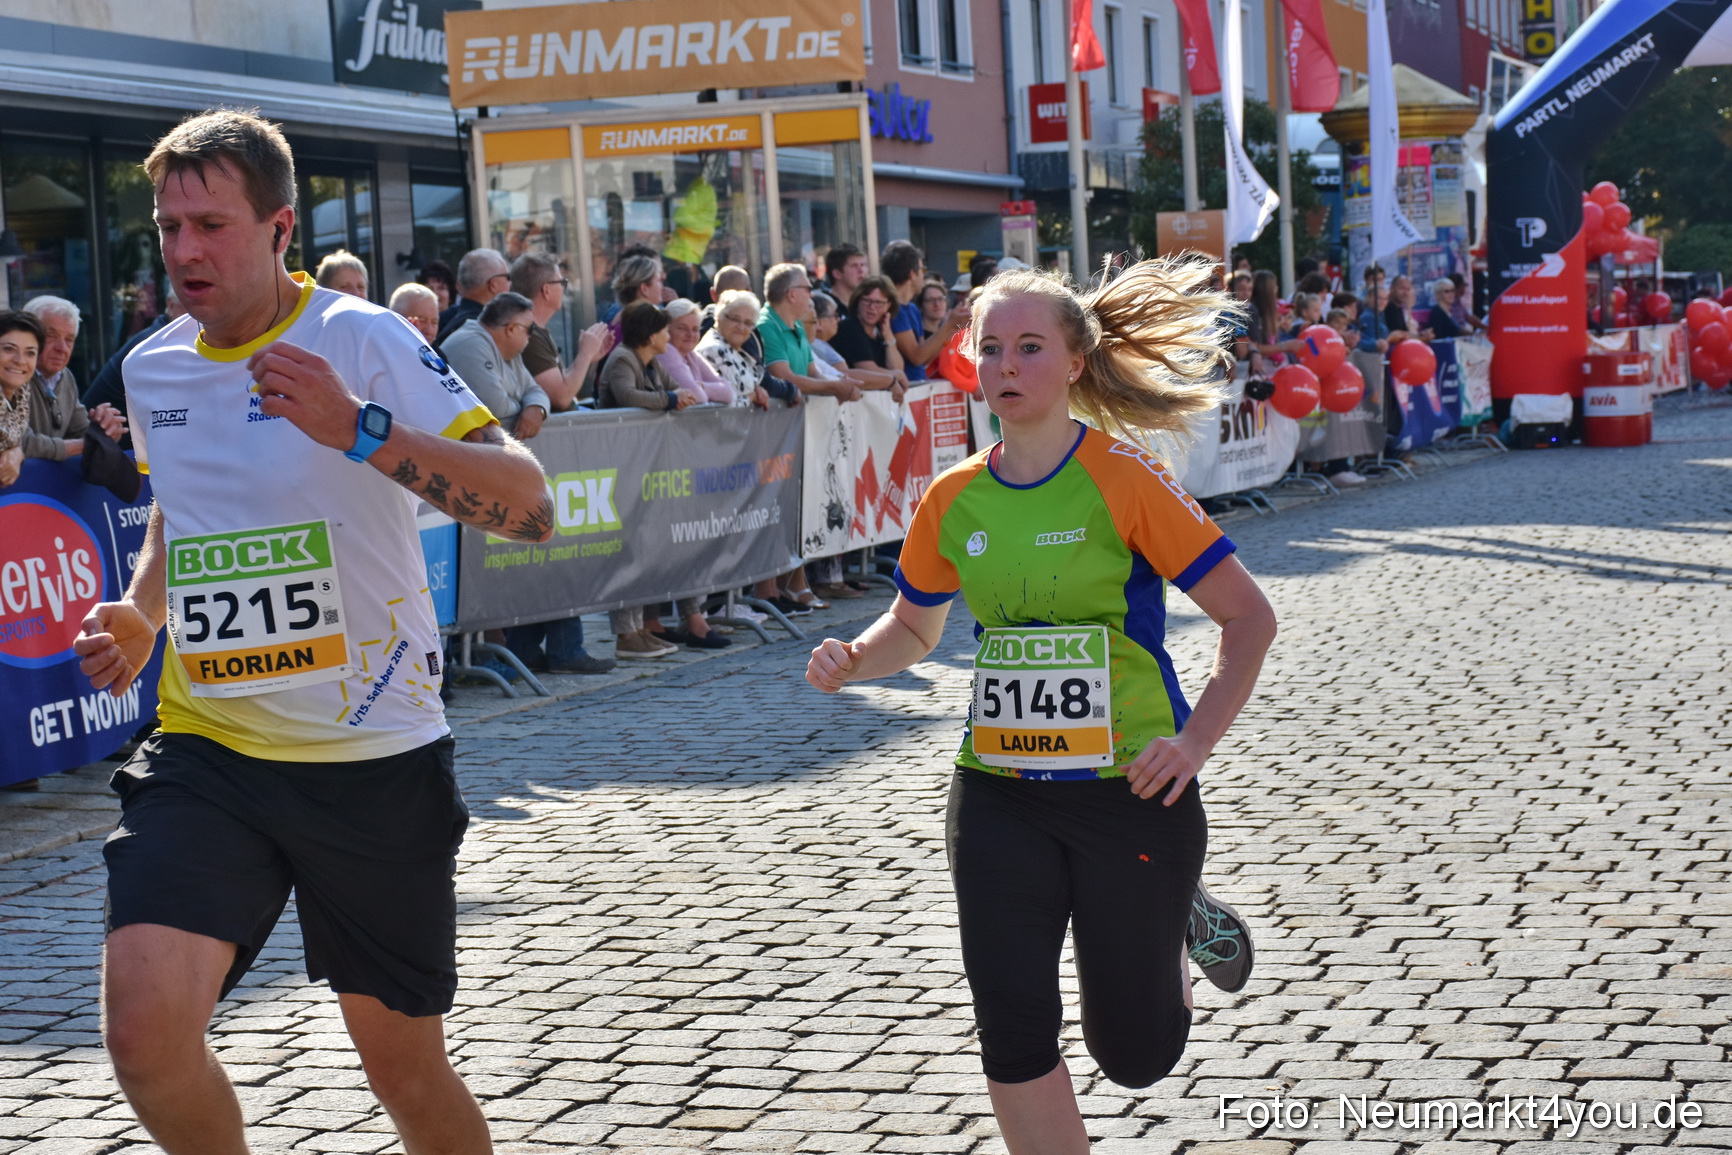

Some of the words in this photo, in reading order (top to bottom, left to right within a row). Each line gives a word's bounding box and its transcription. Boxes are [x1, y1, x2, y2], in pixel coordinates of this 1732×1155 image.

[462, 15, 842, 83] RUNMARKT.DE
[1514, 97, 1569, 139] PARTL
[1565, 32, 1655, 104] NEUMARKT
[1037, 101, 1068, 119] WIT
[600, 124, 748, 150] RUNMARKT.DE
[151, 409, 188, 424] BOCK
[642, 469, 692, 501] OFFICE
[484, 546, 530, 568] inspired
[532, 545, 547, 566] by
[549, 542, 580, 560] smart
[580, 537, 623, 558] concepts
[1036, 528, 1087, 546] BOCK
[175, 529, 319, 580] BOCK
[0, 536, 97, 622] ervis
[322, 582, 331, 591] S
[183, 581, 320, 643] 5215
[0, 616, 46, 644] SPORTS
[199, 646, 315, 679] FLORIAN
[390, 640, 410, 666] 2019
[980, 632, 1095, 665] BOCK
[983, 677, 1091, 720] 5148
[1094, 680, 1102, 689] S
[30, 699, 74, 747] GET
[1000, 734, 1070, 752] LAURA
